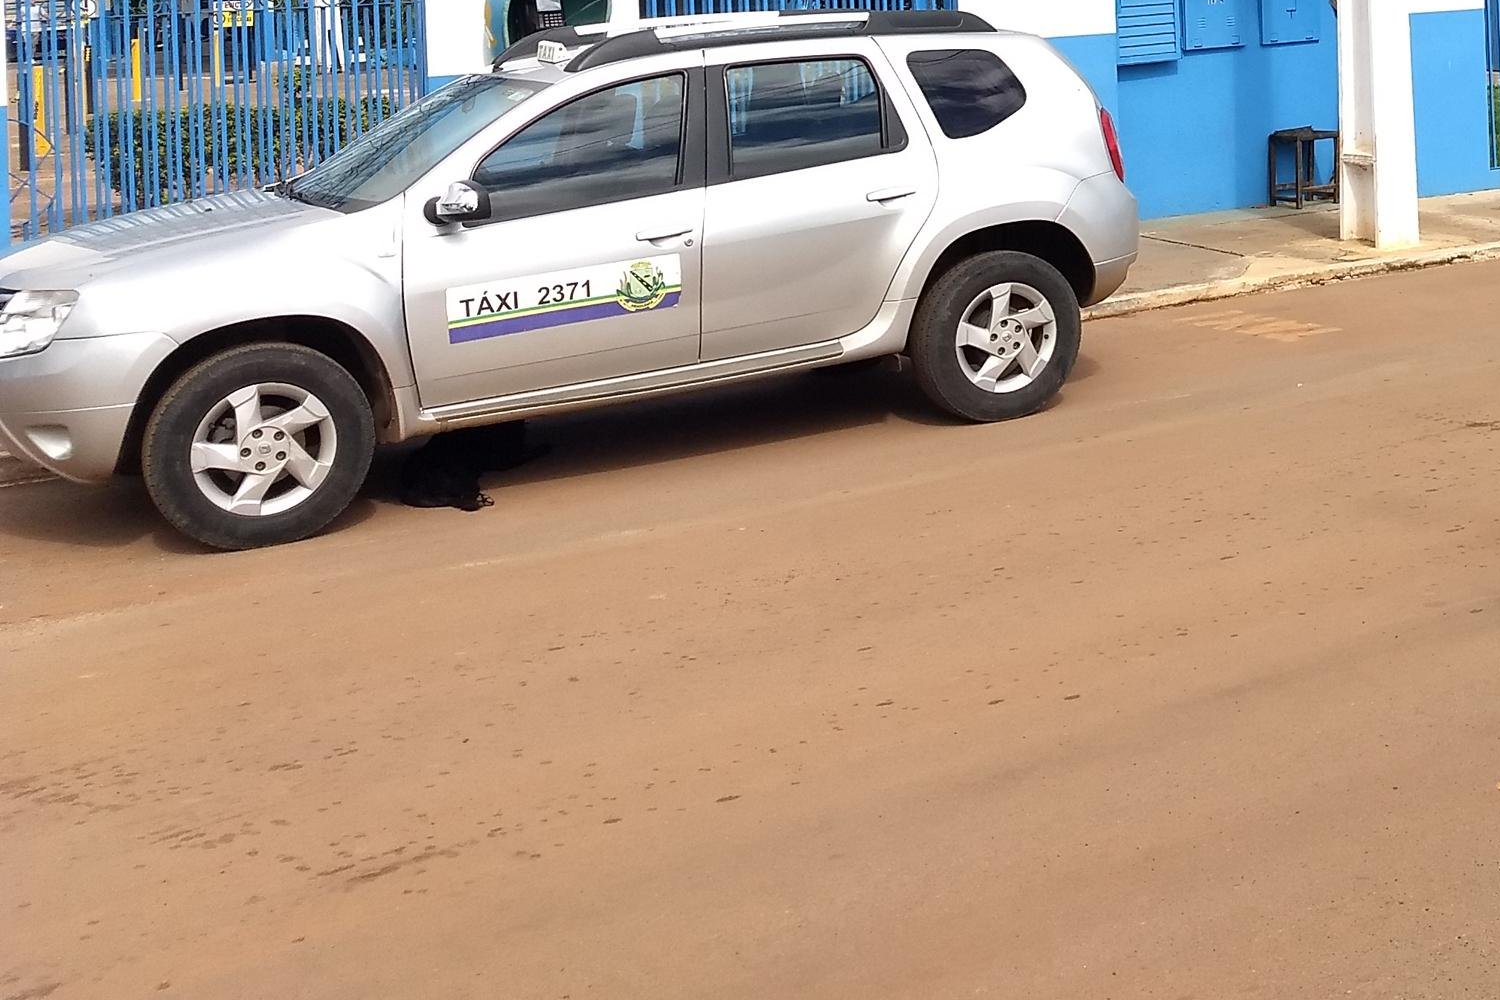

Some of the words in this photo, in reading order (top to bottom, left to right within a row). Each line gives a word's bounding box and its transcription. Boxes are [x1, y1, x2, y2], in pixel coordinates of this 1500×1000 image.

[538, 45, 555, 60] TAXI
[459, 290, 519, 317] TÁXI
[537, 279, 592, 305] 2371
